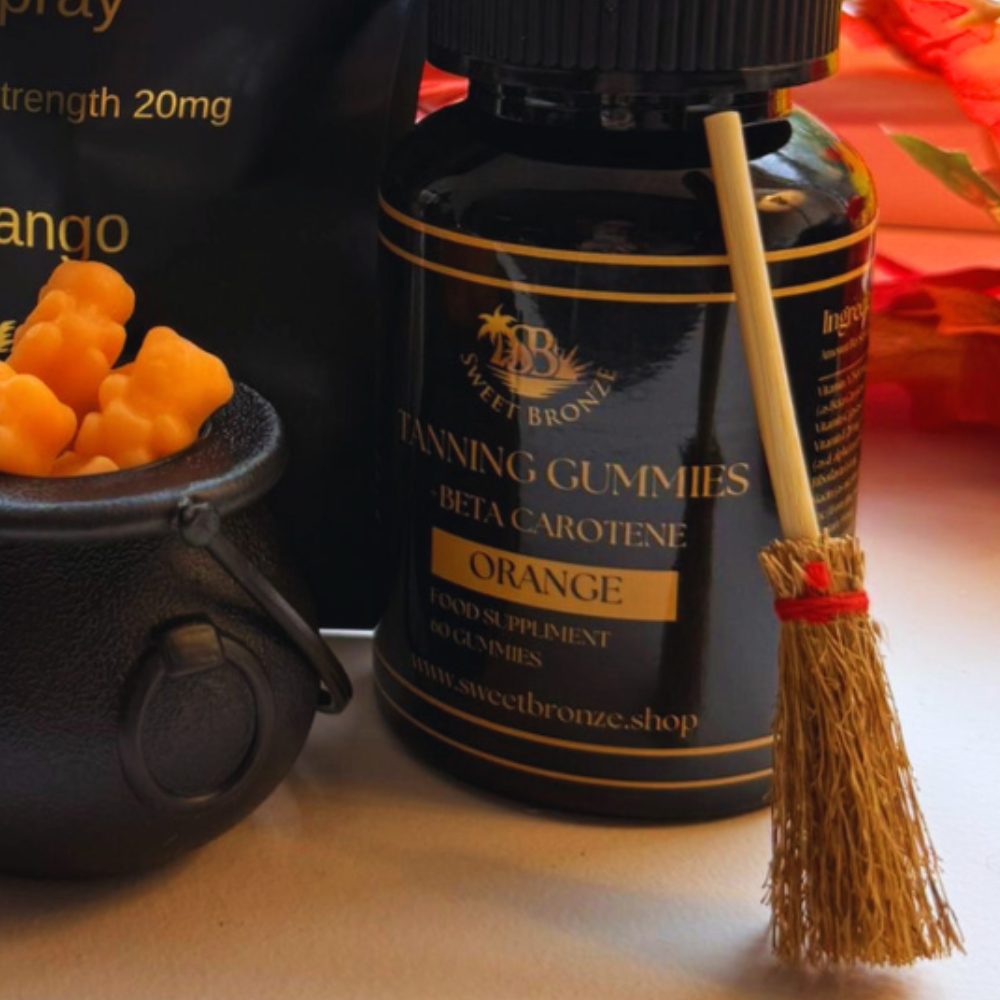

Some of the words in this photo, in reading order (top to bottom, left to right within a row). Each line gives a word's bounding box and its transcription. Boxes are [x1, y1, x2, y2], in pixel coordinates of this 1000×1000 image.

[133, 90, 233, 126] 20mg
[460, 352, 521, 420] SWEET
[528, 366, 619, 426] BRONZE
[398, 409, 537, 484] TANNING
[547, 457, 750, 498] GUMMIES
[511, 507, 688, 548] CAROTENE
[430, 587, 480, 620] FOOD
[469, 550, 623, 605] ORANGE
[430, 619, 450, 638] 60
[453, 628, 543, 668] GUMMIES
[411, 653, 699, 738] www.sweetbronze.shop
